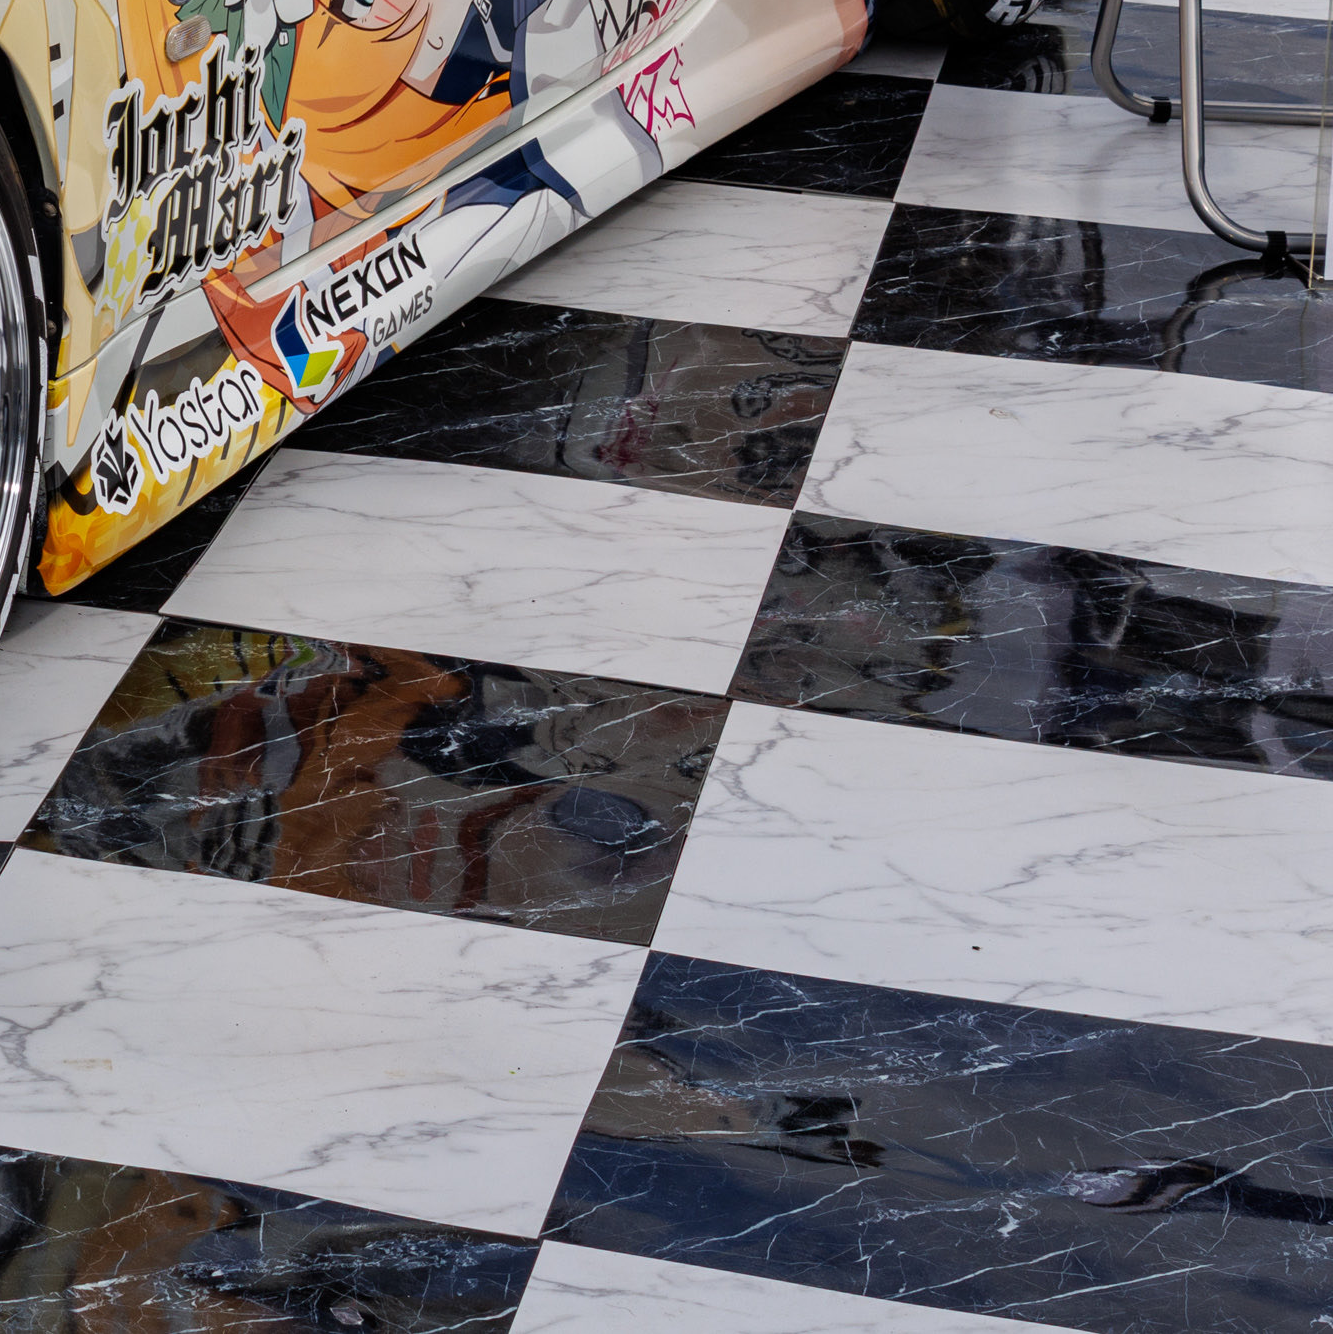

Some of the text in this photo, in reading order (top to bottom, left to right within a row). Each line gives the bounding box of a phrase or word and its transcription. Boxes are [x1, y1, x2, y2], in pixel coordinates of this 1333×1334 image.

[136, 126, 304, 306] Mari
[306, 232, 428, 337] NEXON
[373, 285, 433, 348] GAMES
[131, 369, 262, 475] Yostar
